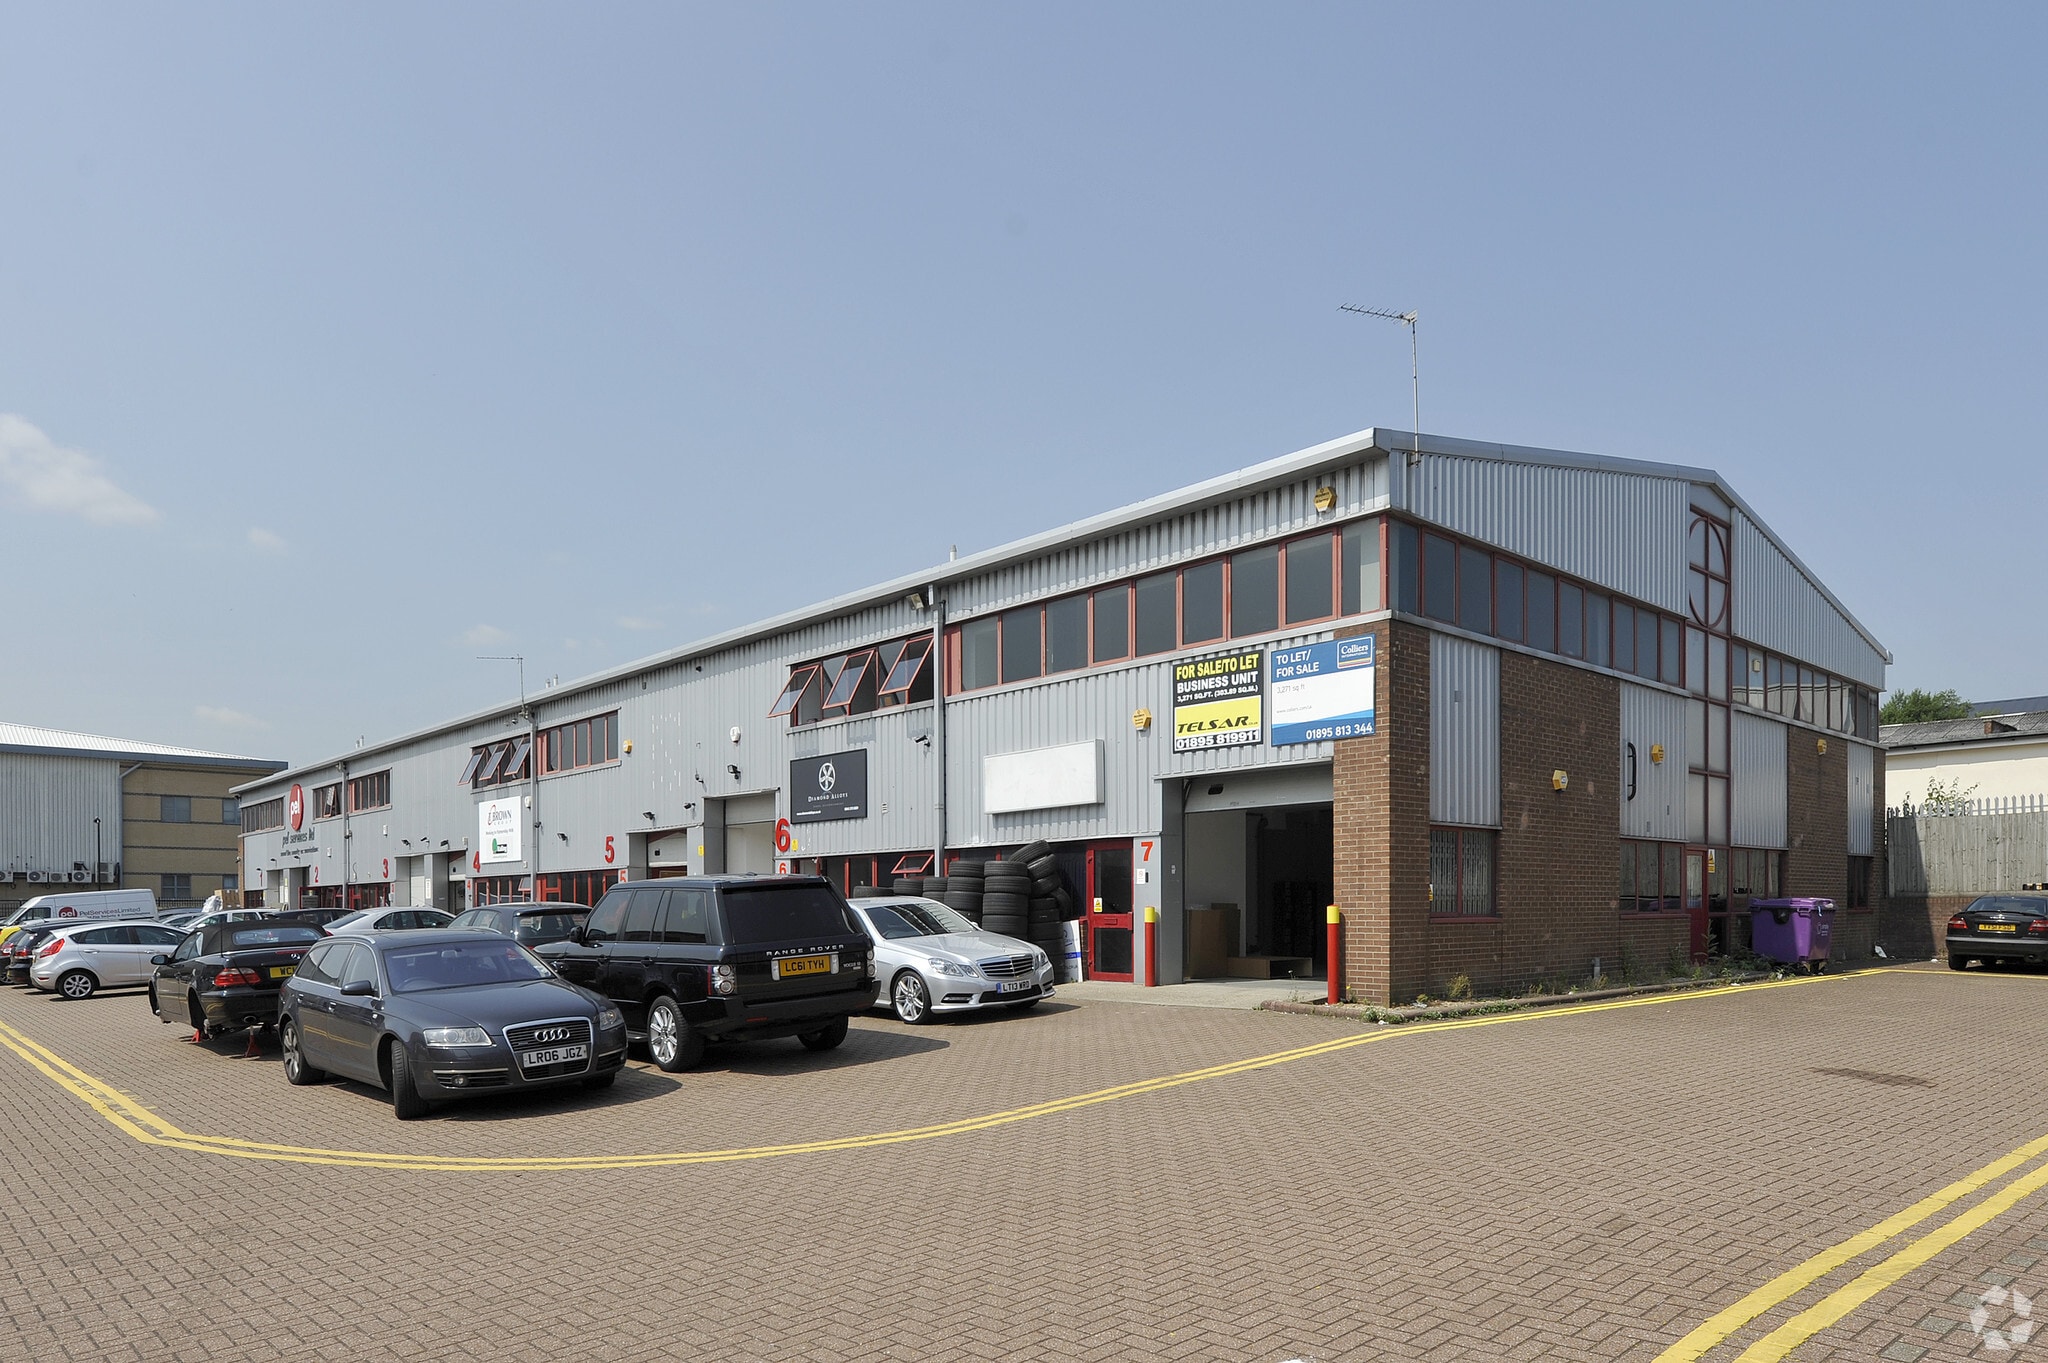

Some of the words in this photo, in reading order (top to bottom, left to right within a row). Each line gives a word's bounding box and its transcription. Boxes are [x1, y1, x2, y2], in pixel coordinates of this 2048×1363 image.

[1276, 654, 1289, 665] TO
[1290, 649, 1312, 663] LET/
[1341, 644, 1369, 655] Colliers
[1176, 664, 1196, 681] FOR
[1240, 653, 1259, 670] LET
[1276, 667, 1295, 678] FOR
[1296, 662, 1320, 675] SALE
[1177, 675, 1229, 693] BUSINESS
[1231, 671, 1258, 686] UNIT
[1276, 685, 1291, 694] 3,271
[1177, 694, 1193, 703] 3,271
[1177, 715, 1249, 734] TELSAR
[1306, 727, 1333, 740] 01895
[1335, 724, 1352, 737] 813
[1354, 722, 1373, 734] 344
[1176, 735, 1214, 749] 01895
[1216, 729, 1259, 744] 819911
[291, 788, 300, 825] pel
[776, 817, 791, 852] 6
[605, 835, 615, 863] 5
[1141, 841, 1154, 861] 7
[382, 858, 389, 879] 3
[472, 850, 481, 873] 4
[779, 862, 787, 875] 6
[314, 865, 319, 883] 2
[466, 880, 471, 890] 4
[766, 948, 803, 957] RANGE
[810, 944, 844, 952] ROVER
[785, 962, 806, 972] LC61
[808, 959, 825, 970] TYH
[1002, 983, 1018, 992] LT13
[528, 1050, 559, 1065] LR06
[562, 1047, 583, 1060] JGZ
